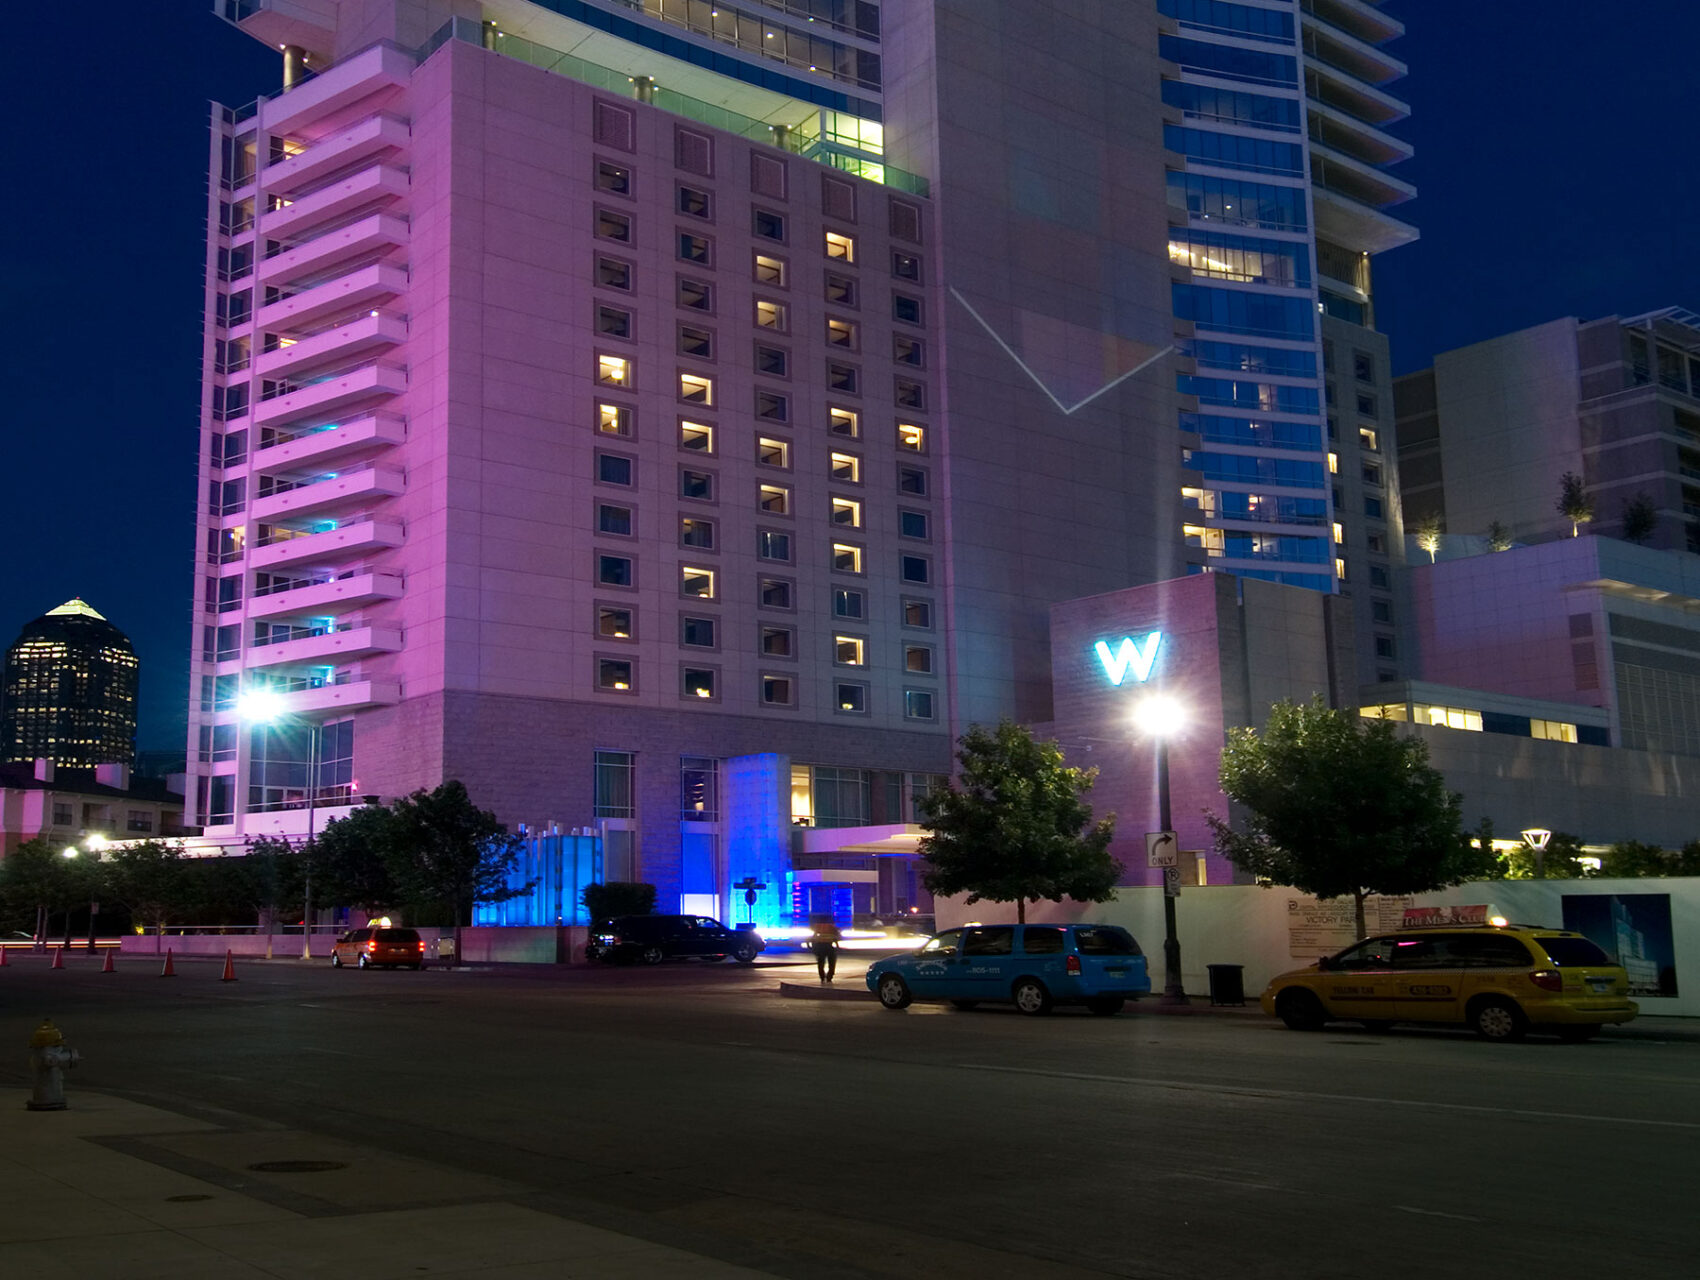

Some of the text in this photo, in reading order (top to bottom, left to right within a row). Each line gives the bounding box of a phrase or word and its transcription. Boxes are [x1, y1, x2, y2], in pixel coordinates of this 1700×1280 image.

[1094, 631, 1162, 687] W
[1152, 856, 1173, 866] ONLY
[1306, 916, 1358, 924] VICTORY PAR
[1404, 917, 1423, 926] THE
